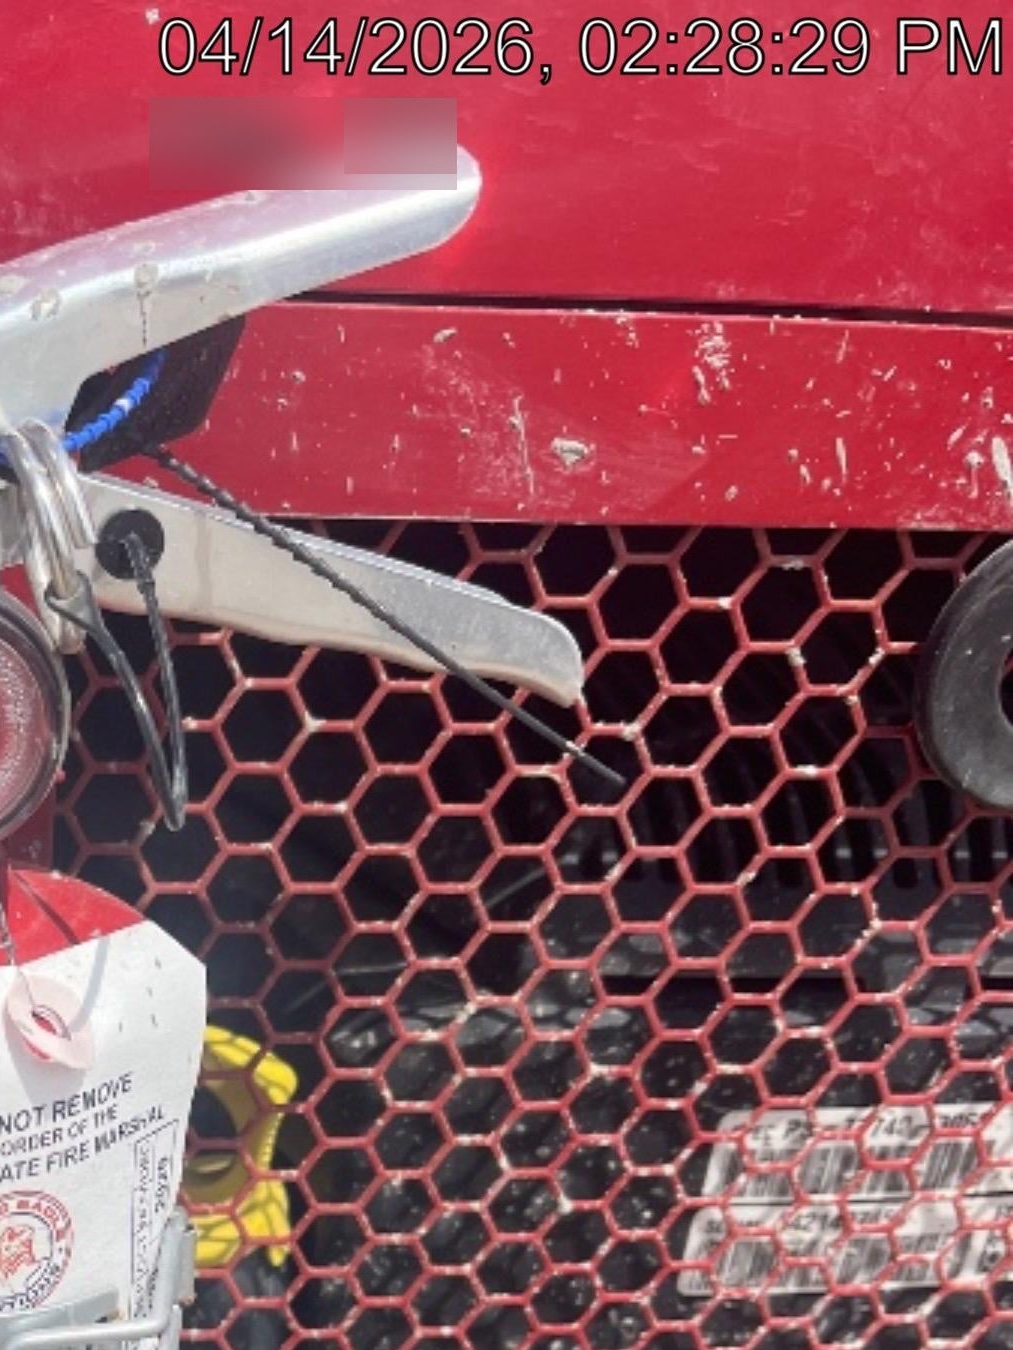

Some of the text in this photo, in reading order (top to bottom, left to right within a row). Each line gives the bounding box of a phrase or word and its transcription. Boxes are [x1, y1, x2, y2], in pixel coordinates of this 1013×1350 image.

[52, 1071, 134, 1123] REMOVE
[1, 1127, 63, 1157] ORDER
[67, 1119, 88, 1138] OF
[93, 1103, 119, 1129] THE
[46, 1140, 91, 1174] FIRE
[95, 1104, 165, 1155] MARSHAL
